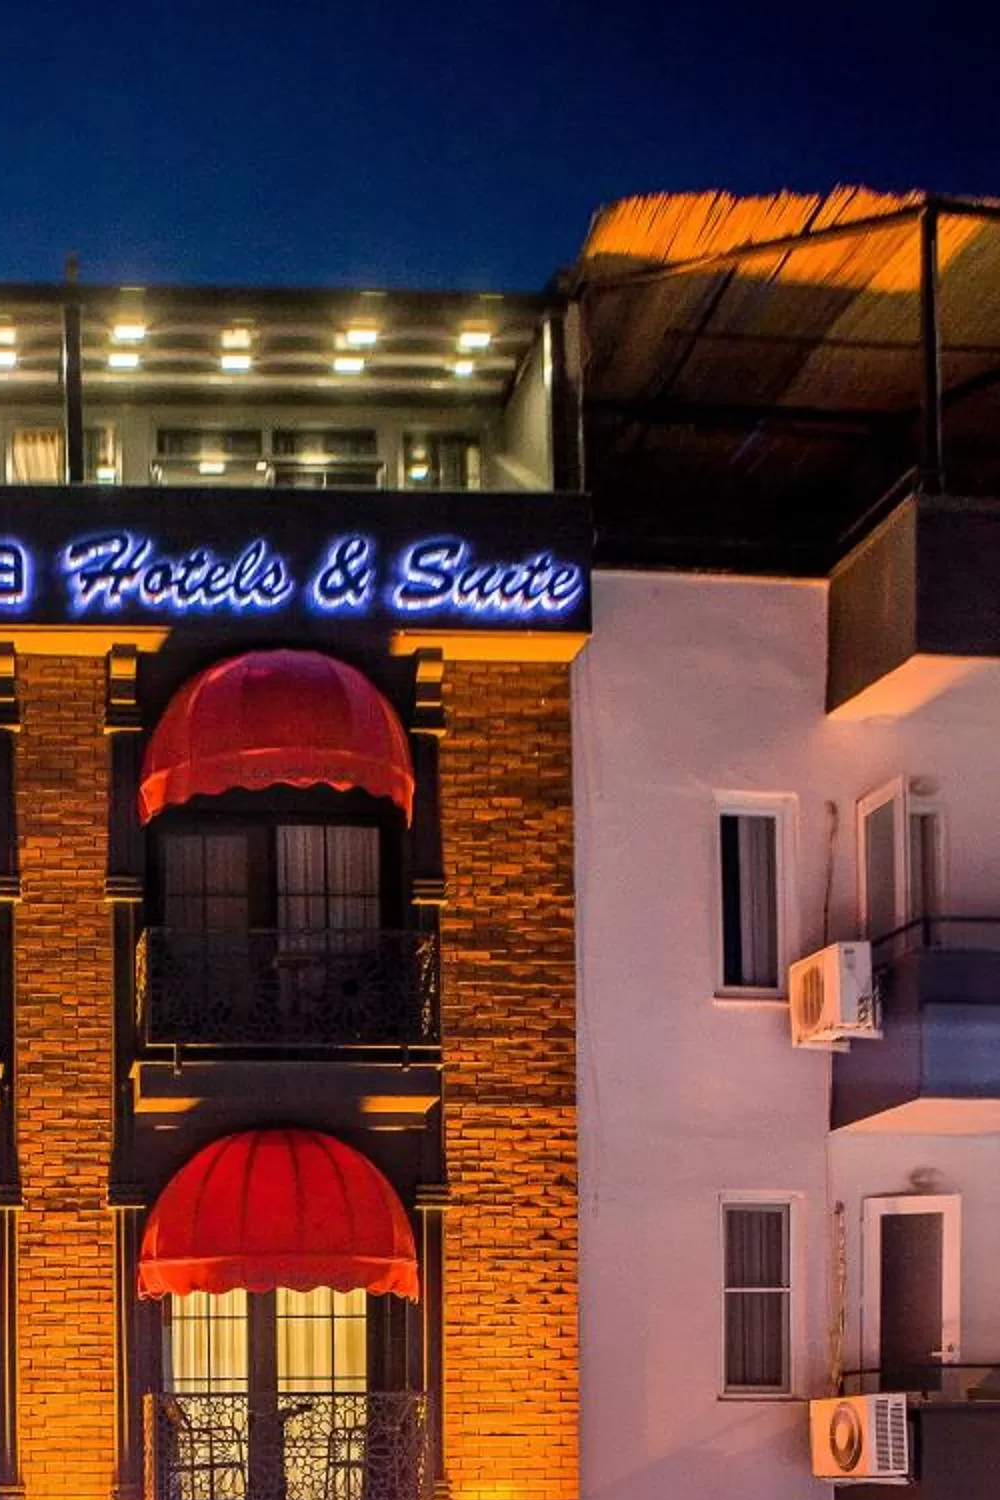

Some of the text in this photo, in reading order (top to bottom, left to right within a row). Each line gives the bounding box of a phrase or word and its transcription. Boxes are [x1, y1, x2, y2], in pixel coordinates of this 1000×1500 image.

[62, 530, 296, 612] Hotels
[313, 533, 374, 608] &
[394, 537, 583, 612] Suite
